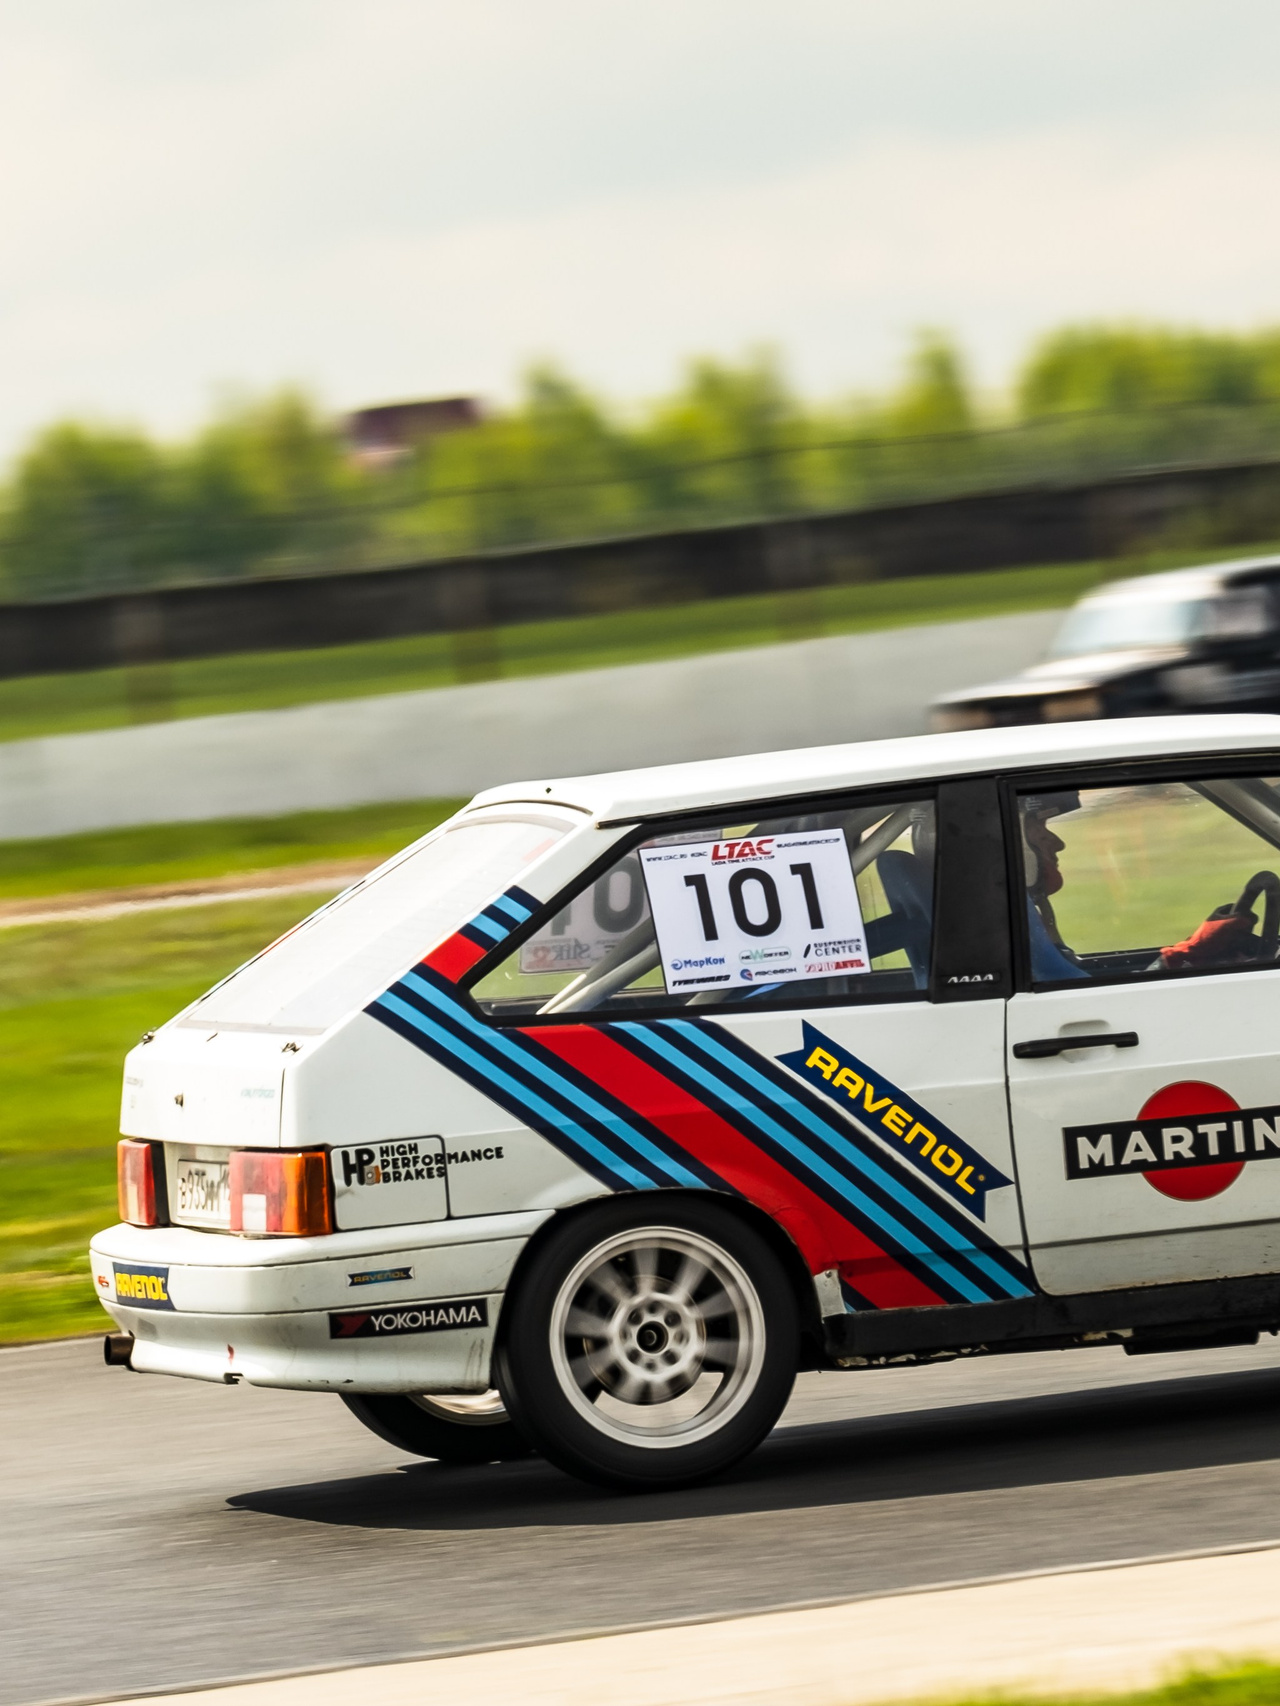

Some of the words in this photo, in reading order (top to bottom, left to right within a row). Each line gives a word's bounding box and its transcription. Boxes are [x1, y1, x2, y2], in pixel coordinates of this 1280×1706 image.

[711, 838, 775, 860] LTAC
[683, 862, 824, 942] 101
[814, 944, 862, 957] CENTER
[805, 1046, 977, 1196] RAVENOL
[380, 1142, 419, 1159] HIGH
[380, 1146, 505, 1171] PERFORMANCE
[382, 1166, 446, 1184] BRAKES
[115, 1272, 168, 1300] RAVENOL
[353, 1271, 407, 1283] RAVENOL
[371, 1305, 482, 1331] YOKOHAMA
